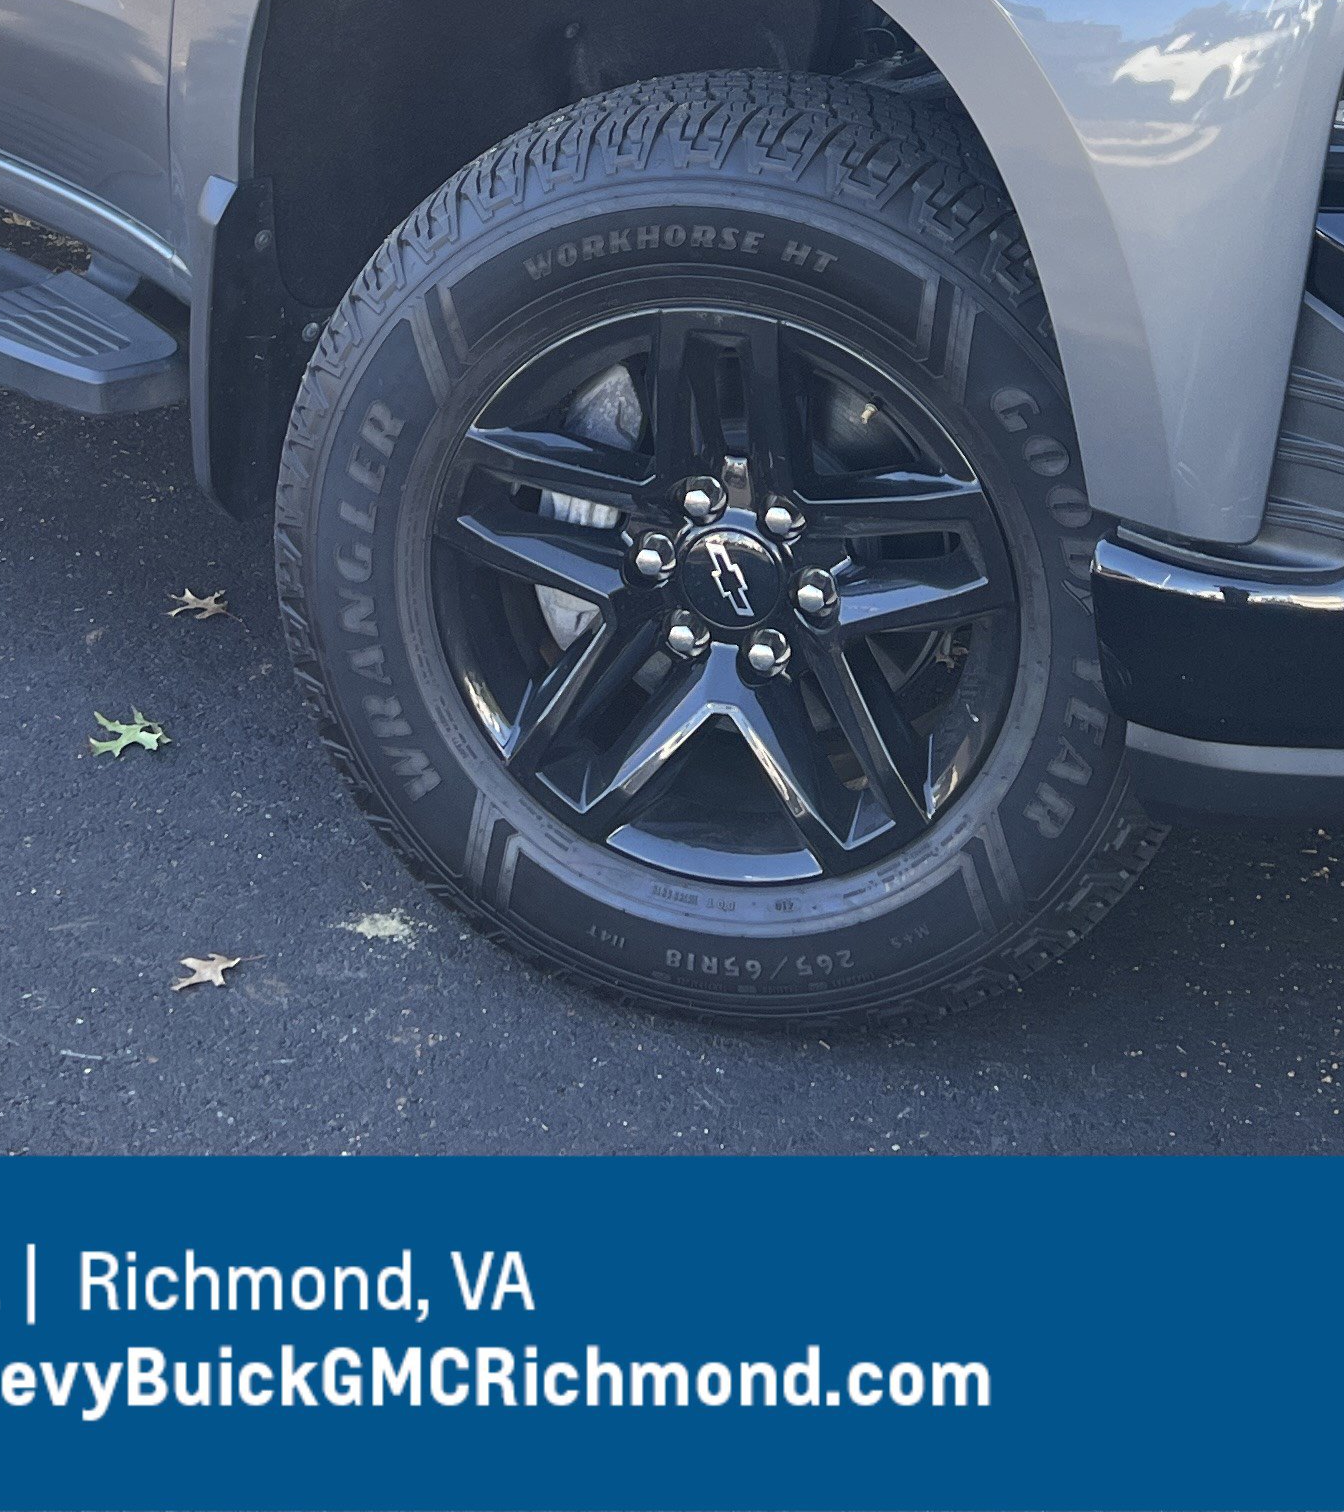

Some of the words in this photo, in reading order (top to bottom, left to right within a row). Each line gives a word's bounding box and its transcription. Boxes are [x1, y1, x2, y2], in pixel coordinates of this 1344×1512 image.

[523, 224, 765, 281] WORKHORSE
[781, 240, 838, 273] HT
[334, 398, 441, 802] WRANGLER
[665, 948, 855, 981] 265/65R18
